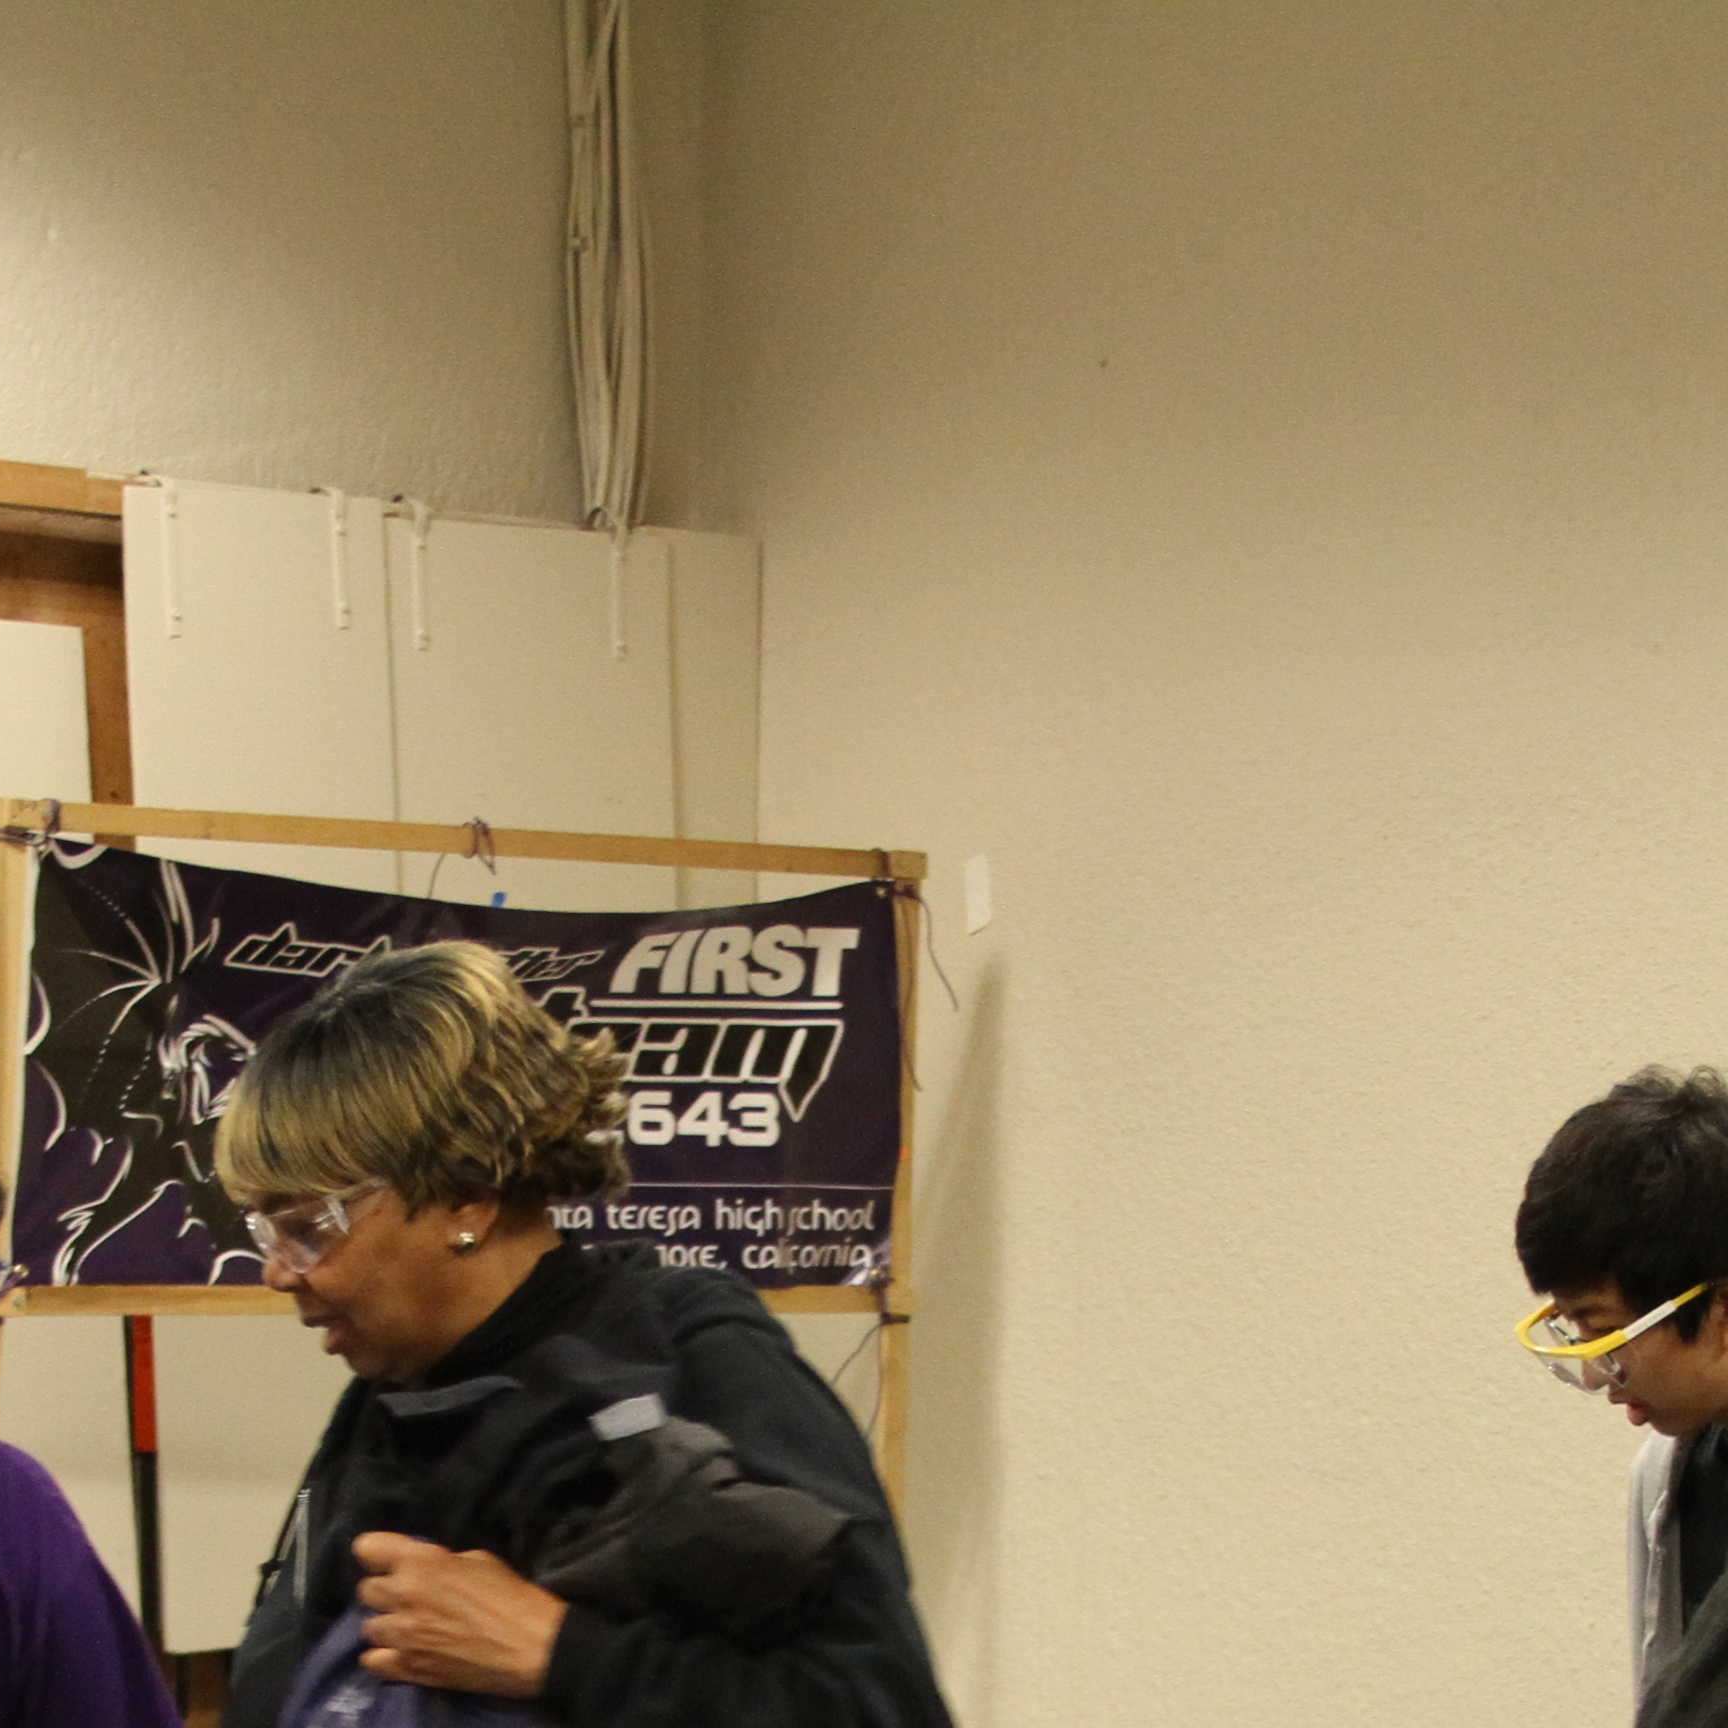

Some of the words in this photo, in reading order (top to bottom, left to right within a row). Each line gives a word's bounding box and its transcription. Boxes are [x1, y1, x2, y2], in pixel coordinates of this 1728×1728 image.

[609, 925, 861, 998] FIRST
[584, 1089, 781, 1148] 643
[547, 1203, 594, 1231] nta
[606, 1204, 702, 1237] teresa
[715, 1198, 780, 1237] high
